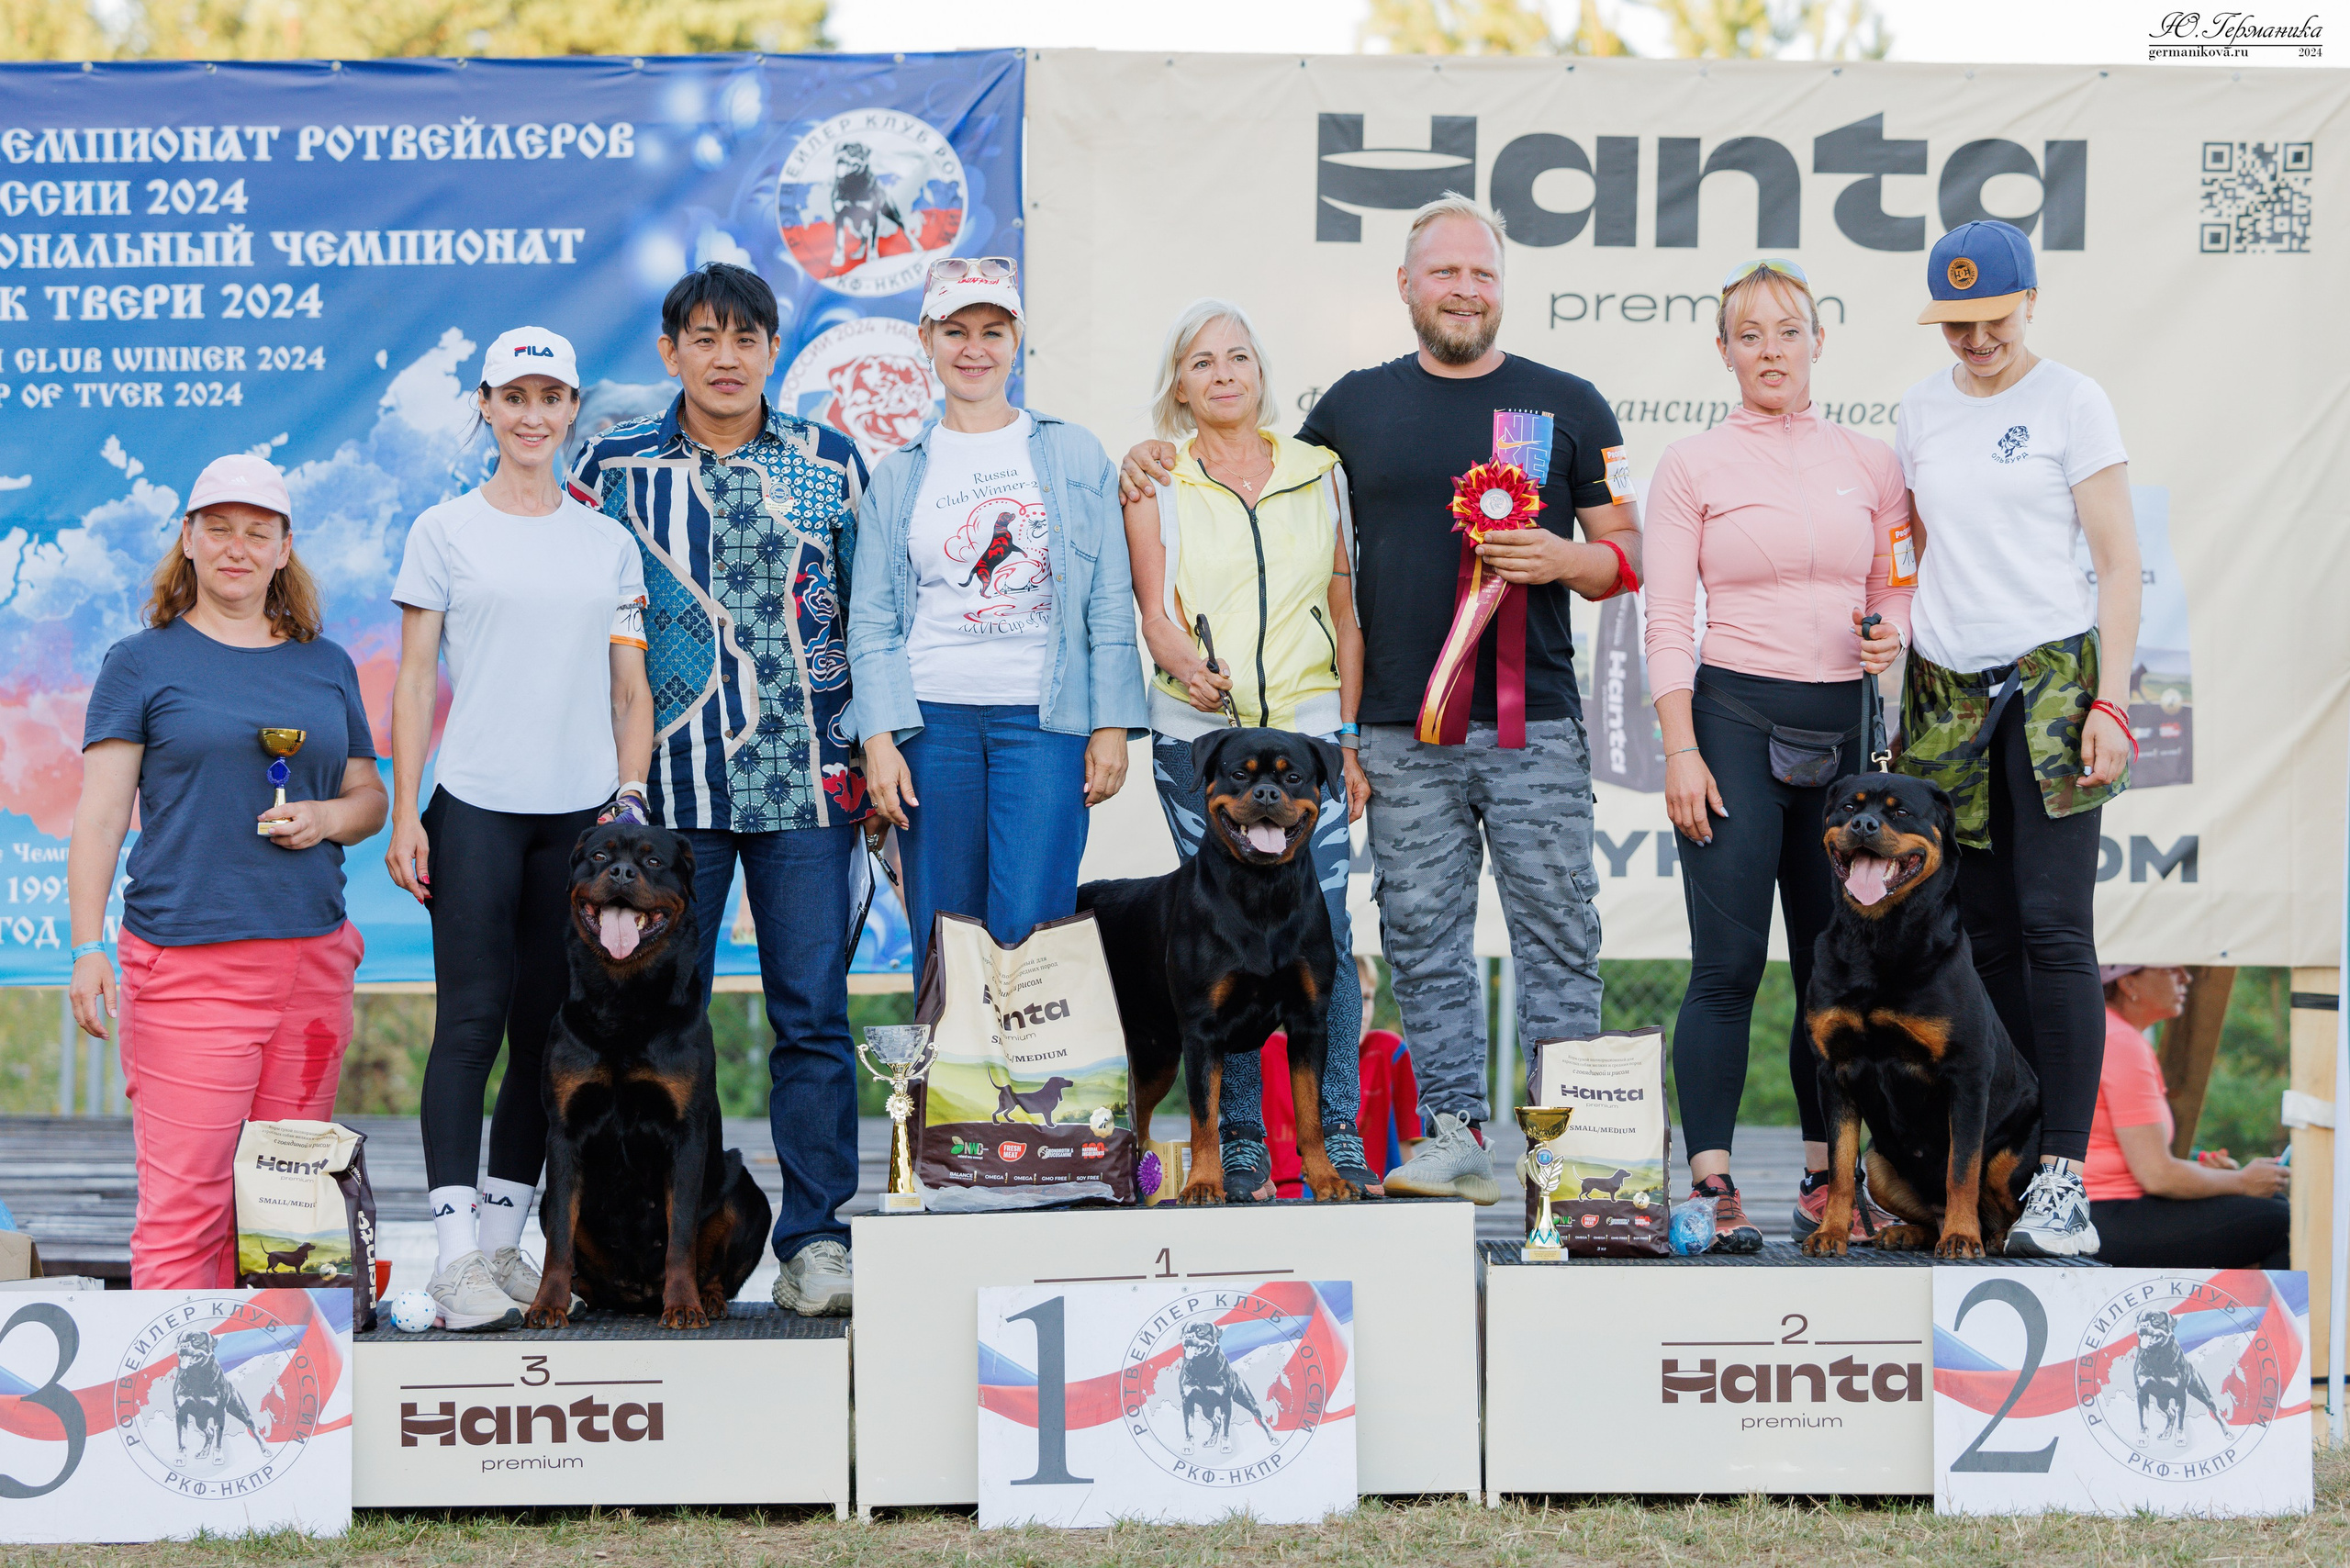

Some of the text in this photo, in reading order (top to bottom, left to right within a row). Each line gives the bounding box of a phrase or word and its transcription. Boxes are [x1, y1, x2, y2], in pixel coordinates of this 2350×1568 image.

[1, 116, 635, 163] ЕМПИОНАТ РОТВЕЙЛЕРОВ
[866, 116, 928, 142] КЛУБ
[1316, 111, 2086, 252] Hanta
[0, 178, 249, 217] ССИИ 2024
[0, 223, 586, 269] ОНАЛЬНЫЙ ЧЕМПИОНАТ
[0, 283, 324, 320] К ТВЕРИ 2024
[1550, 293, 1844, 329] prem
[837, 323, 875, 341] 2024
[15, 347, 103, 373] CLUB
[111, 346, 247, 372] WINNER
[256, 345, 327, 371] 2024
[514, 345, 554, 358] FILA
[21, 383, 64, 409] OF
[73, 383, 164, 407] TVER
[174, 381, 244, 407] 2024
[1991, 452, 2030, 465] ОЛЬБУРД
[973, 468, 1018, 484] Russia
[936, 480, 1039, 509] Club Winner-2
[620, 608, 645, 633] 10
[998, 619, 1025, 633] Cup
[1026, 610, 1039, 628] of
[1036, 610, 1050, 624] Tv
[1607, 650, 1628, 774] Hanta
[1017, 978, 1043, 991] рисом
[983, 984, 1070, 1031] Hnta
[1561, 1084, 1643, 1102] Hanta
[1569, 1126, 1636, 1134] SMALL/MEDIUM
[1155, 1247, 1179, 1278] 1
[1780, 1313, 1808, 1344] 2
[520, 1355, 550, 1385] 3
[1125, 1294, 1323, 1437] РОТВЕЙЛЕР КЛУБ РОССИИ
[2079, 1282, 2277, 1429] РОТВЕЙЛЕР КЛУБ РОССИИ
[118, 1302, 317, 1447] РОТВЕЙЛЕР КЛУБ РОССИИ
[1005, 1295, 1094, 1485] 1
[1662, 1354, 1923, 1405] Hanta
[1950, 1278, 2059, 1473] 2
[0, 1302, 86, 1498] 3
[400, 1394, 664, 1448] Hanta
[1740, 1413, 1843, 1431] premium
[481, 1457, 585, 1473] premium
[1173, 1453, 1283, 1484] РКФ-НКПР
[2127, 1449, 2236, 1479] РКФ-НКПР
[164, 1464, 274, 1496] РКФ-НКПР
